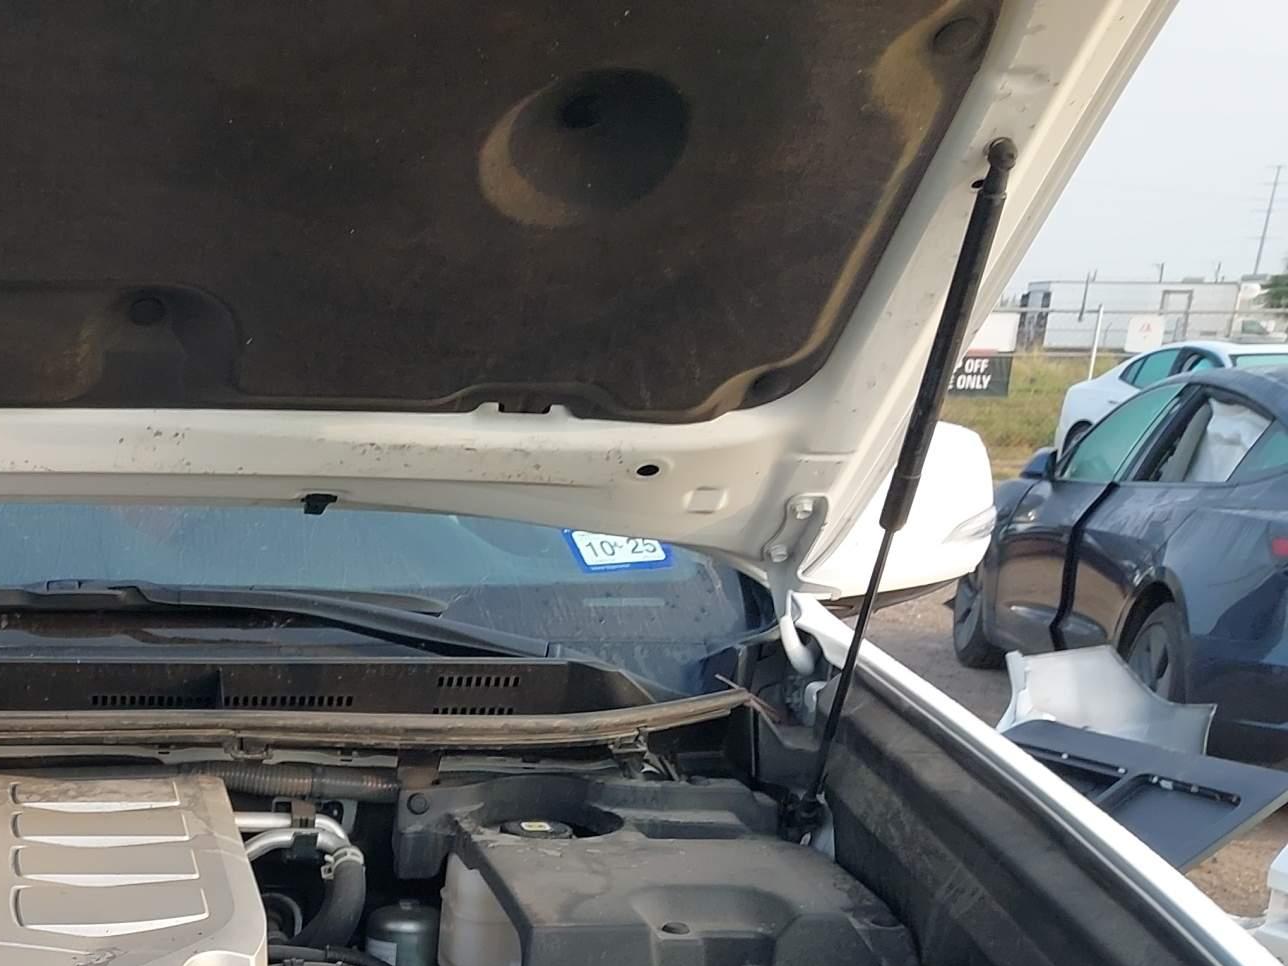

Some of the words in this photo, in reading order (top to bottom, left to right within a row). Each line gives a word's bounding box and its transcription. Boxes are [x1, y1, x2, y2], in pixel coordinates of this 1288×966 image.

[964, 358, 990, 374] OFF
[956, 374, 992, 390] ONLY
[585, 540, 616, 558] 10
[626, 537, 657, 554] 25
